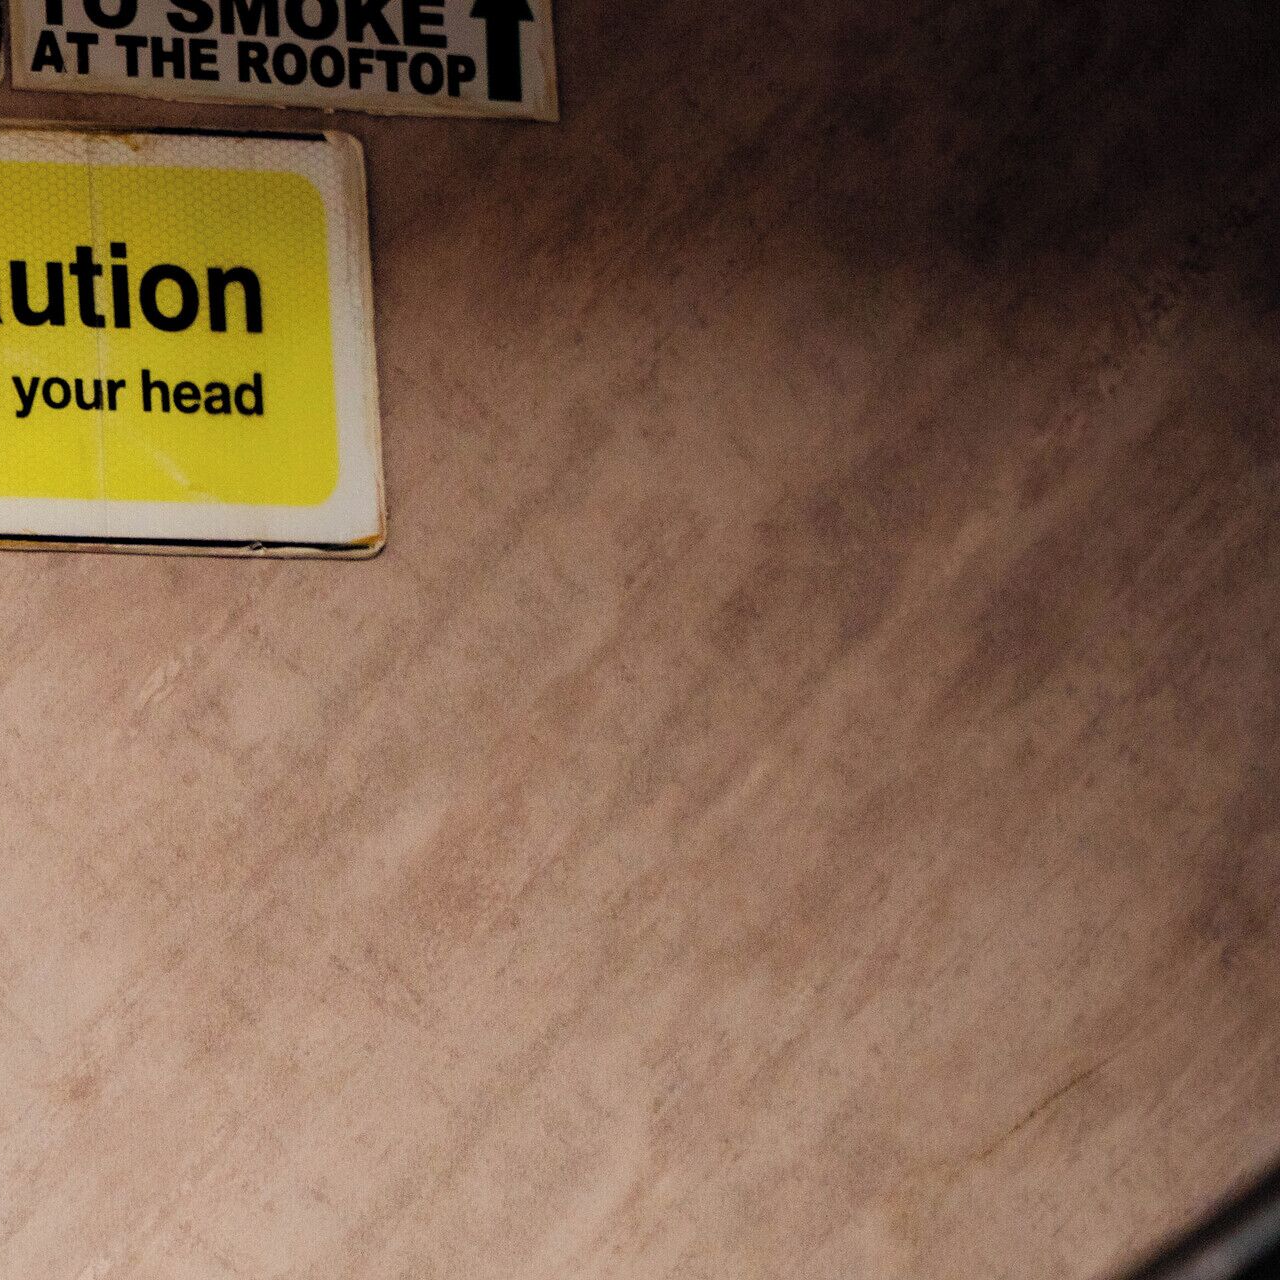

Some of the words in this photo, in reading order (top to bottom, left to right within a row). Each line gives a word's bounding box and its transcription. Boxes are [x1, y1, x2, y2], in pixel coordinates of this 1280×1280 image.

[165, 0, 448, 48] SMOKE
[30, 30, 99, 75] AT
[115, 34, 220, 81] THE
[237, 40, 477, 97] ROOFTOP
[11, 374, 127, 418] your
[141, 369, 264, 416] head
